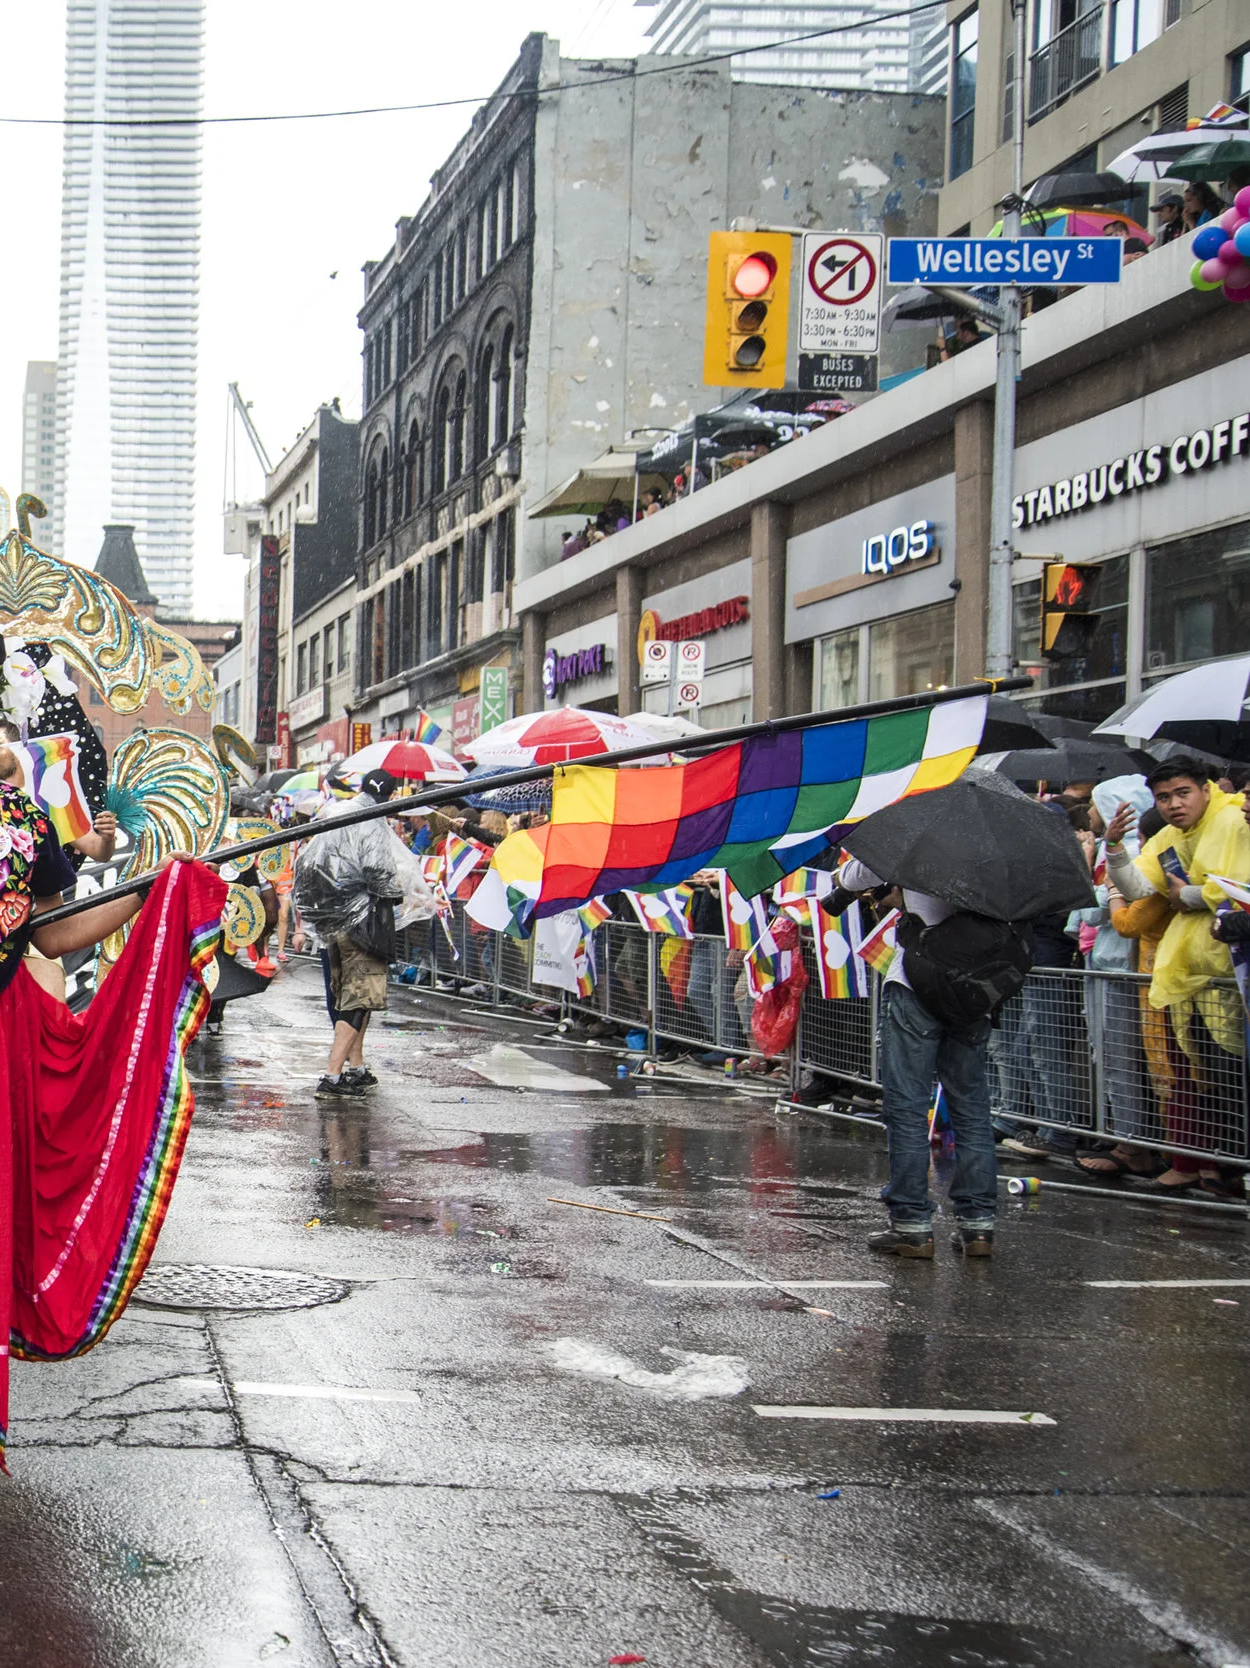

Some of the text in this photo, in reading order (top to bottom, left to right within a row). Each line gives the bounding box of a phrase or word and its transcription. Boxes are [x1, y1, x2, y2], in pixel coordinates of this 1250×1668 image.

[916, 243, 1094, 280] Wellesley St
[820, 339, 838, 347] MON
[844, 340, 858, 348] FRI
[822, 358, 854, 371] BUSES
[813, 374, 862, 388] EXCEPTED
[1011, 412, 1250, 529] STARBUCKS COFF
[861, 519, 931, 575] IQOS
